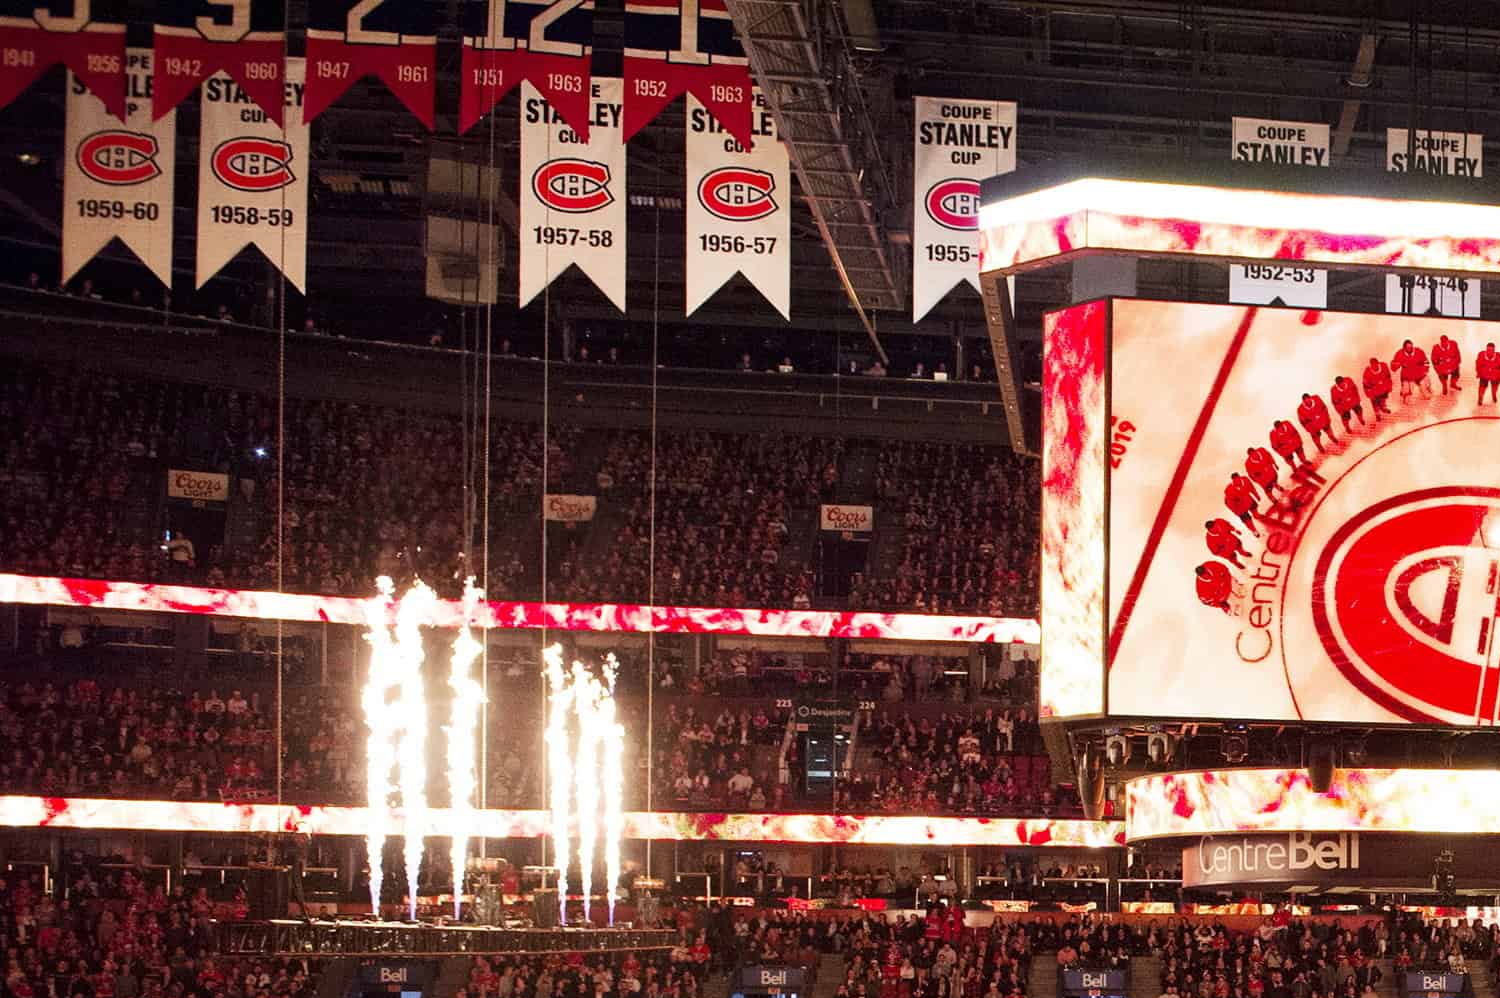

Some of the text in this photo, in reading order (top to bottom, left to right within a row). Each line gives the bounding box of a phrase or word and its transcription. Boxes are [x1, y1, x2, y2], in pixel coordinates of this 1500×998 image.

[2, 48, 36, 67] 1941
[87, 55, 120, 74] 1956
[164, 57, 201, 77] 1942
[244, 62, 278, 80] 1960
[316, 62, 350, 79] 1947
[397, 66, 428, 83] 1961
[473, 69, 504, 86] 1951
[547, 74, 583, 93] 1963
[634, 80, 667, 98] 1952
[709, 84, 744, 103] 1963
[940, 104, 992, 121] COUPE
[918, 122, 1013, 149] STANLEY
[1256, 125, 1307, 142] COUPE
[1414, 135, 1460, 153] COUPE
[950, 150, 982, 165] CUP
[1236, 142, 1327, 167] STANLEY
[76, 199, 160, 222] 1959-60
[210, 205, 293, 227] 1958-59
[533, 226, 614, 249] 1957-58
[698, 234, 777, 255] 1956-57
[925, 244, 979, 263] 1955-
[1241, 264, 1316, 284] 1952-53
[380, 967, 407, 983] Bell
[761, 970, 787, 985] Bell
[1082, 973, 1107, 988] Bell
[1423, 975, 1446, 990] Bell
